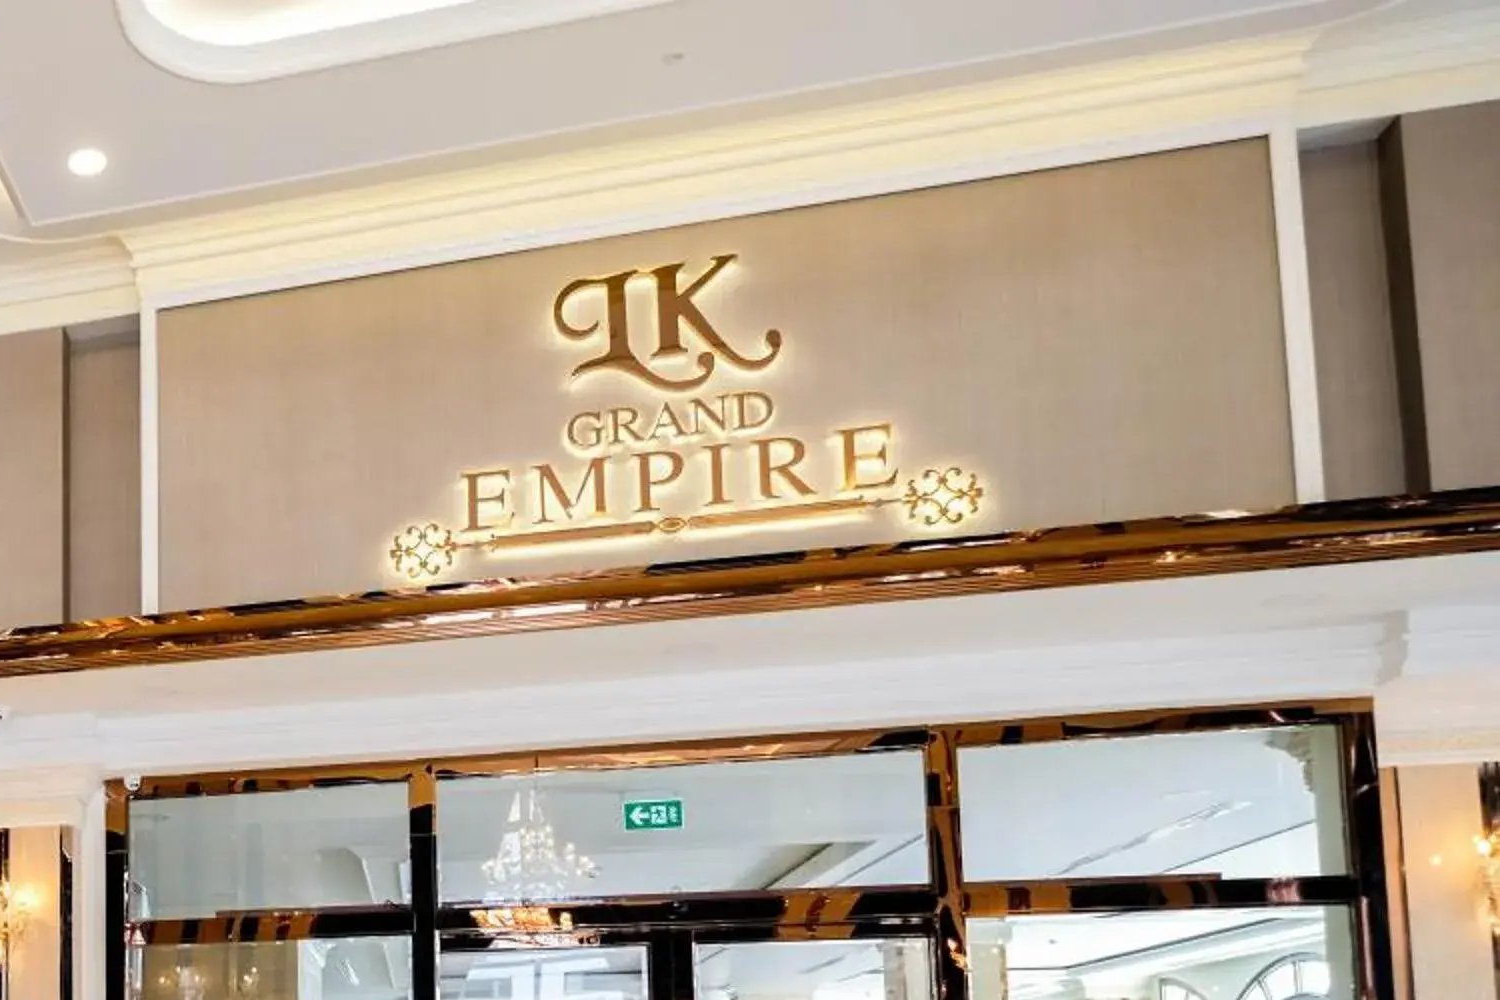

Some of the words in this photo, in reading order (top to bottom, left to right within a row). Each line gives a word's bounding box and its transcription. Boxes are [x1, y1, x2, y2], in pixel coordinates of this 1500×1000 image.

[553, 253, 782, 391] LK
[567, 391, 775, 447] GRAND
[460, 423, 900, 532] EMPIRE
